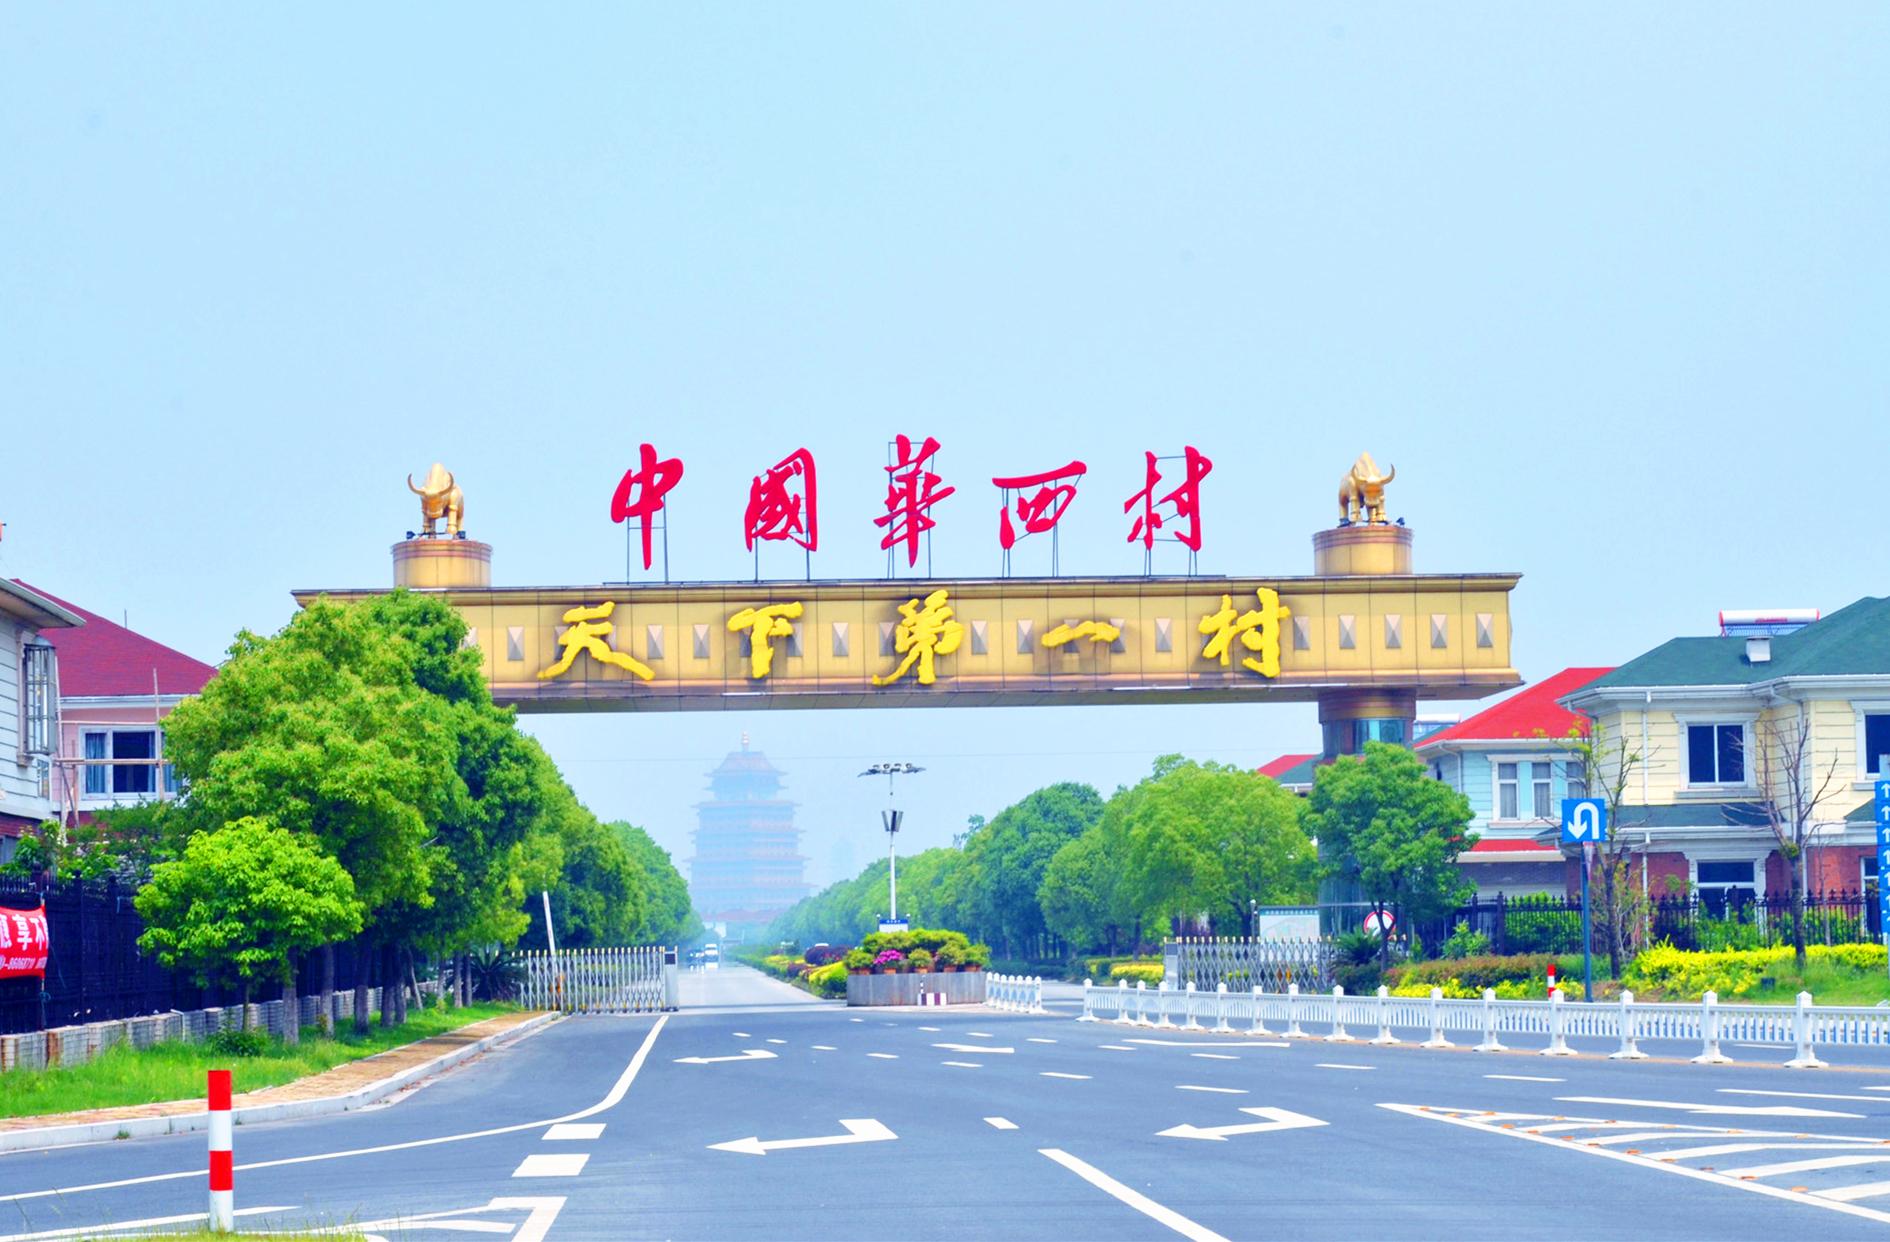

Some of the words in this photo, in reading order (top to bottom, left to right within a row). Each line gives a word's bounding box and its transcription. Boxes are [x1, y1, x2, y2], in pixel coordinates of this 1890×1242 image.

[610, 434, 1212, 569] 中國華西村
[537, 587, 1291, 686] 天下第一村
